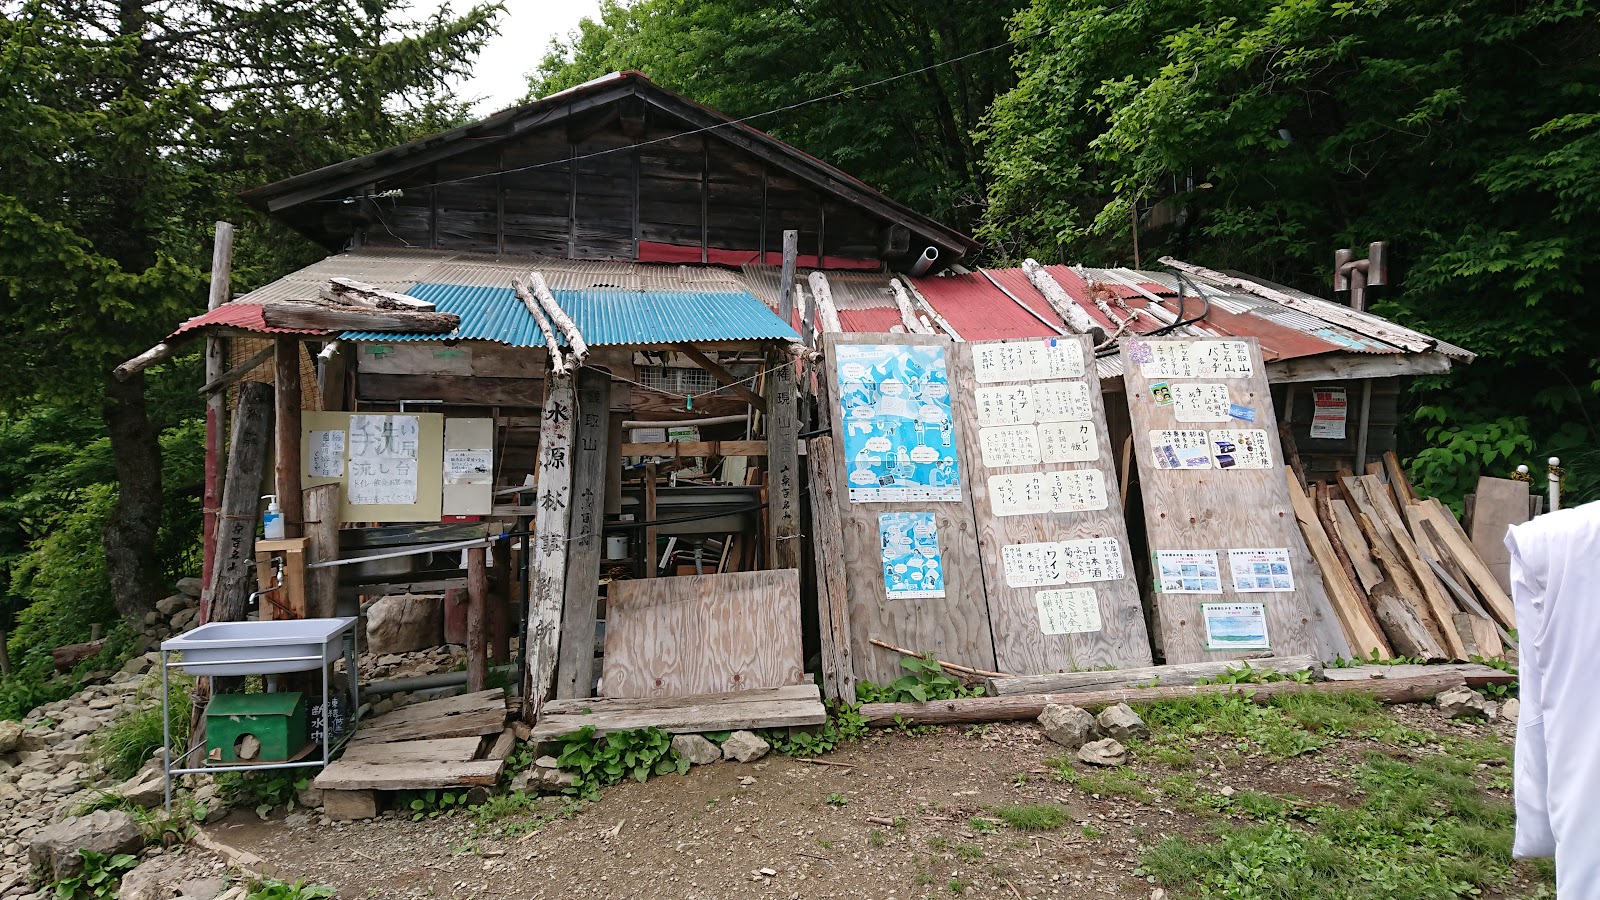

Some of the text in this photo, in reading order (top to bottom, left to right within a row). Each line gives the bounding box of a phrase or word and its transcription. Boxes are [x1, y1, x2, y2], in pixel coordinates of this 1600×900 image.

[1007, 347, 1016, 370] サイダー
[1016, 347, 1024, 366] コーラ
[1029, 348, 1039, 365] ビール
[1156, 344, 1169, 376] 手ぬぐい
[1234, 344, 1251, 373] 雲取山
[1008, 394, 1021, 423] ヌードル
[1017, 388, 1028, 410] カップ
[1079, 424, 1089, 452] カレー
[997, 485, 1005, 505] ゼリー
[1025, 483, 1033, 502] メイト
[1032, 477, 1040, 501] カロリー
[1046, 550, 1060, 580] ワイン
[1063, 546, 1076, 569] 菊水
[1073, 546, 1085, 576] ふなぐち
[1087, 545, 1102, 578] 日本酒
